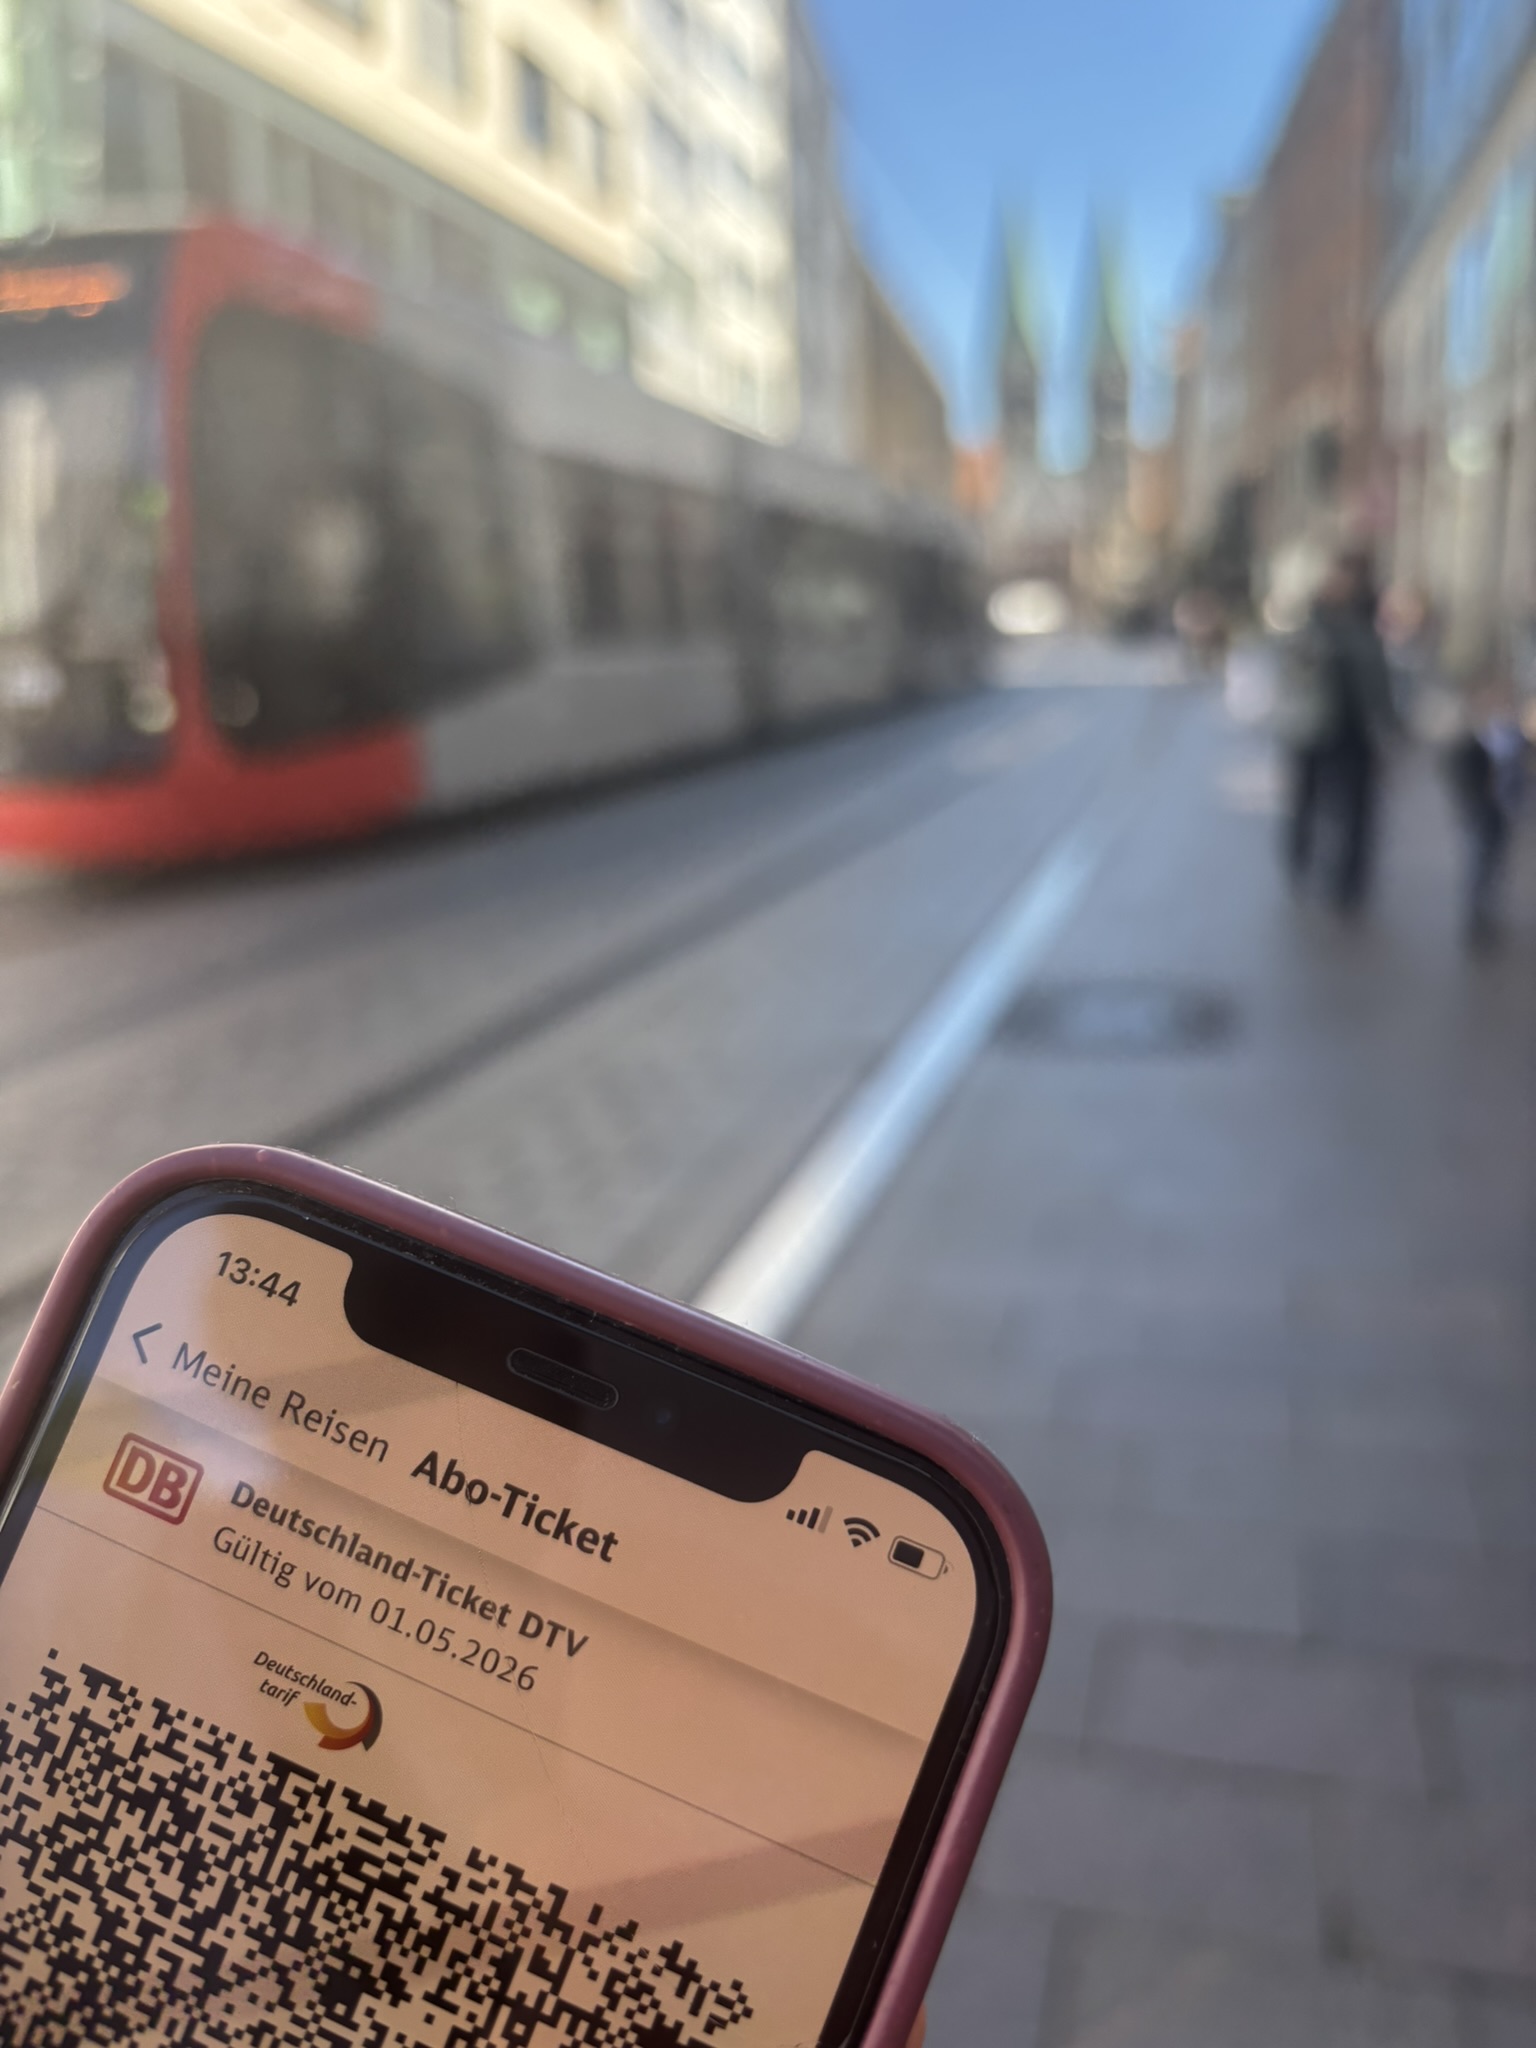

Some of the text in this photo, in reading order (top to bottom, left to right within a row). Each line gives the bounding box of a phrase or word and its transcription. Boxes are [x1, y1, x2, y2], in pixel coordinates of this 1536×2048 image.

[217, 1251, 302, 1307] 13:44
[172, 1342, 390, 1462] Meine Reisen
[118, 1443, 190, 1511] DB
[411, 1450, 619, 1564] Abo-Ticket
[212, 1525, 539, 1691] Gültig vom 01.05.2026
[230, 1480, 589, 1658] Deutschland-Ticket DTV
[253, 1650, 358, 1708] Deutschland-
[259, 1678, 301, 1708] tarif
